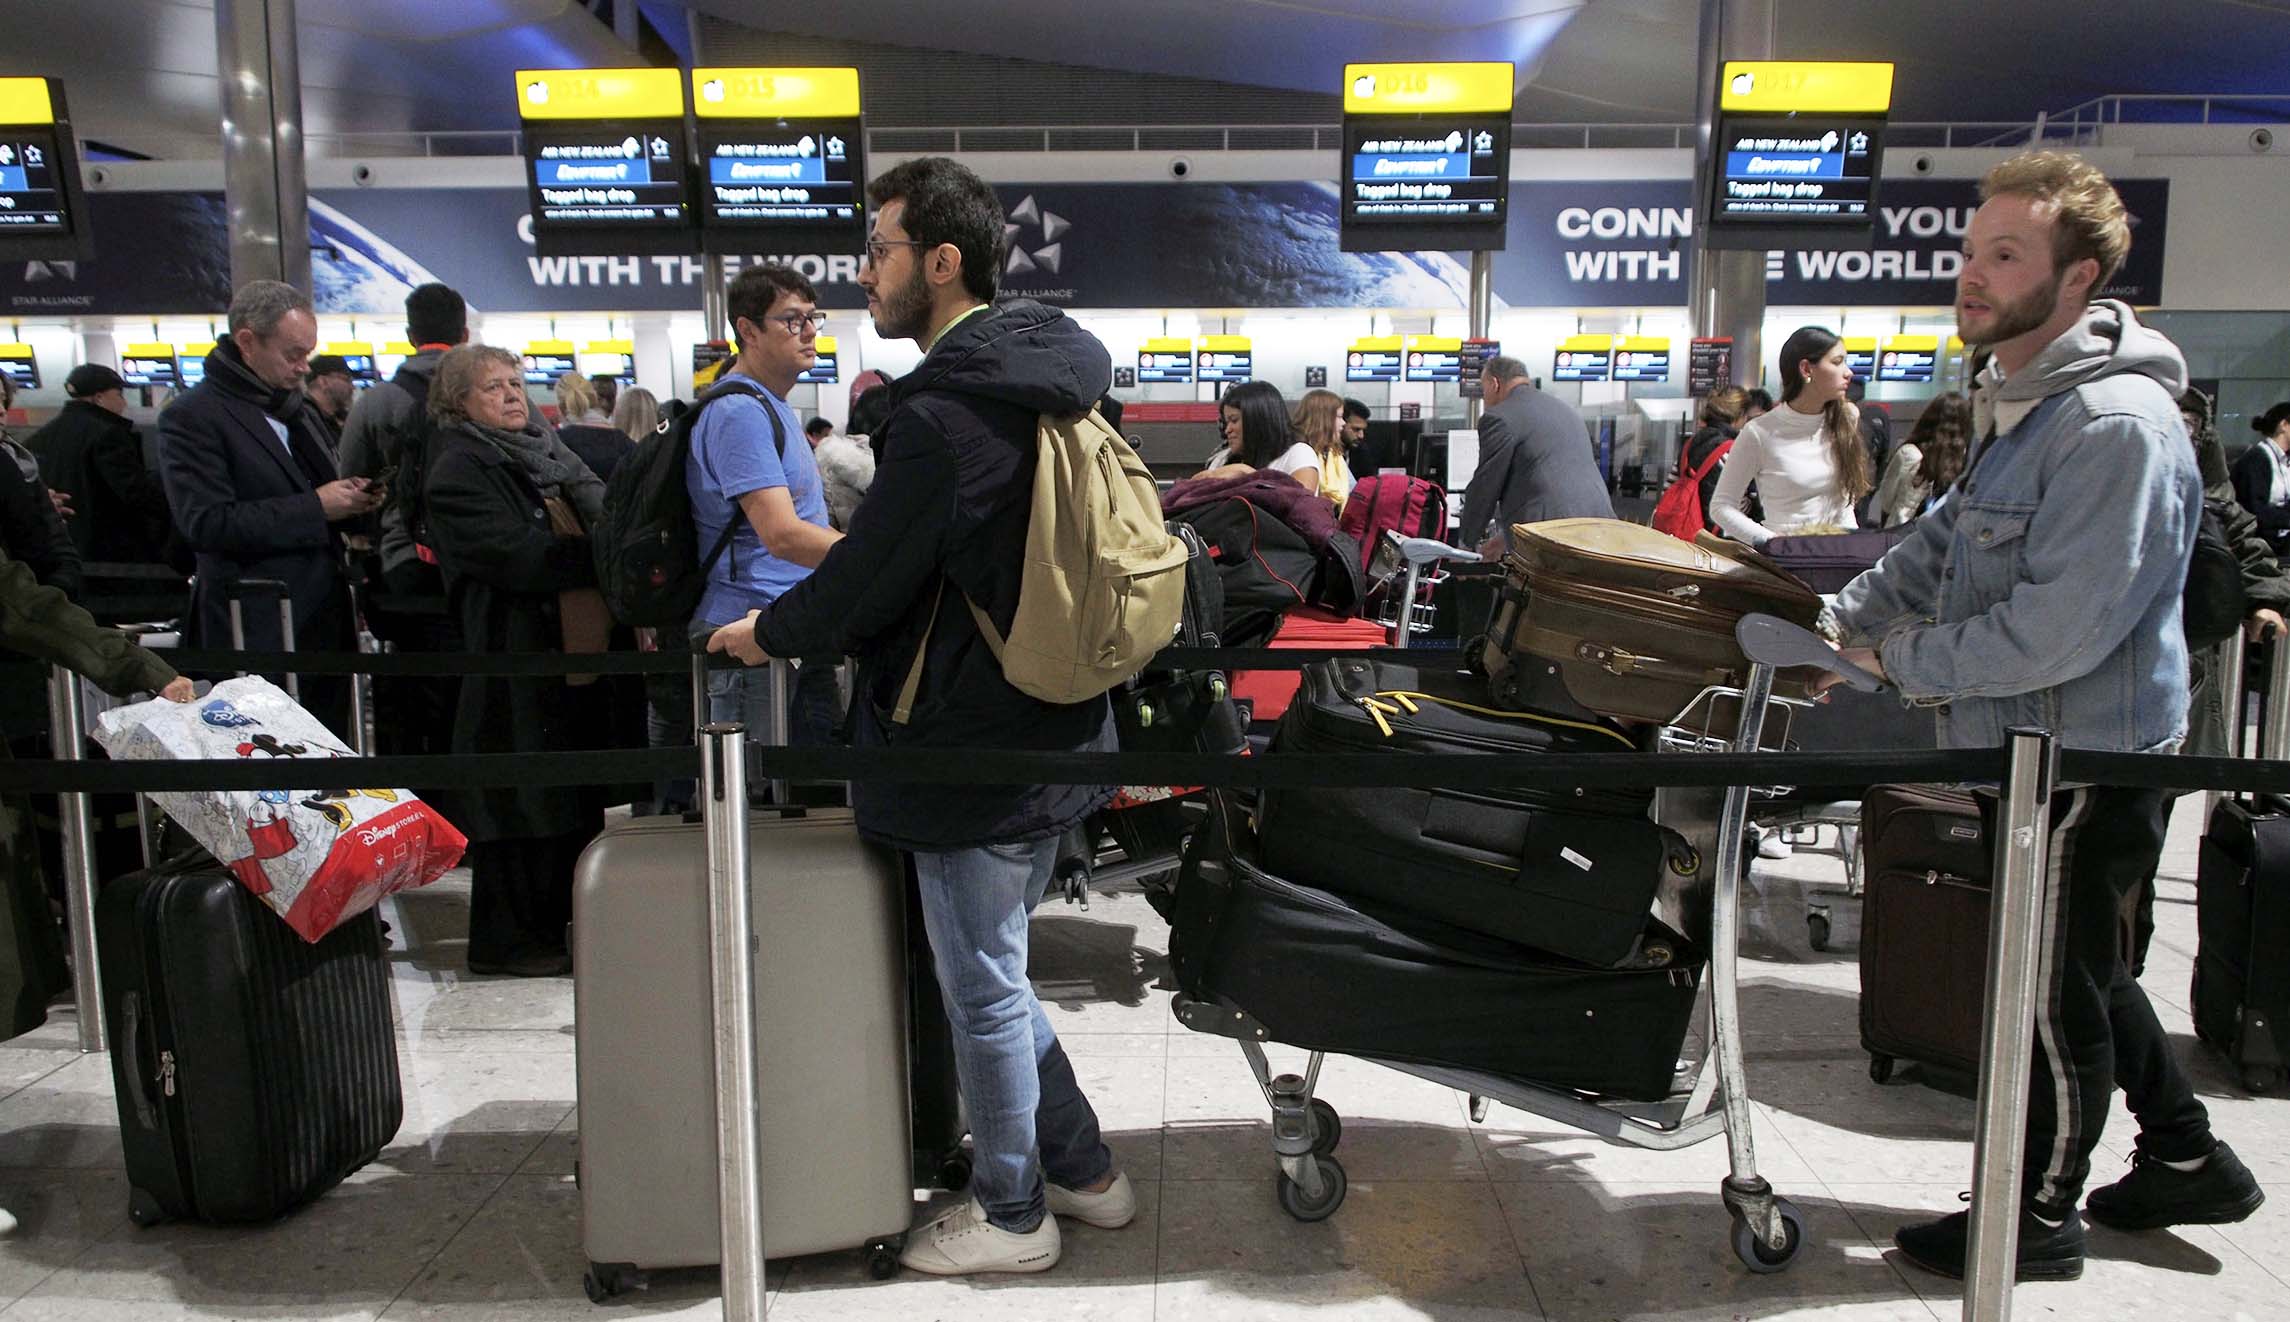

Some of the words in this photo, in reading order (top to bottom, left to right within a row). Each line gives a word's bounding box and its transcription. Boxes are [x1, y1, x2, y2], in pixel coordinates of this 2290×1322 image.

[733, 78, 775, 99] D15
[1384, 73, 1428, 93] D16
[1360, 141, 1379, 153] AIR
[1380, 141, 1401, 153] NEW
[1401, 141, 1445, 153] ZEALAND
[1736, 139, 1754, 151] AIR
[1755, 139, 1777, 151] NEW
[1776, 139, 1820, 151] ZEALAND
[541, 188, 583, 205] Tagged
[584, 188, 607, 205] bag
[607, 188, 637, 204] drop
[715, 186, 757, 203] Tagged
[758, 186, 781, 203] bag
[781, 186, 809, 203] drop
[1356, 182, 1399, 200] Tagged
[1400, 182, 1422, 200] bag
[1423, 182, 1451, 199] drop
[1728, 181, 1770, 198] Tagged
[1771, 182, 1794, 199] bag
[1795, 182, 1823, 199] drop
[528, 255, 640, 285] WITH
[1565, 251, 1680, 281] WITH
[1797, 251, 1964, 281] WORLD
[1021, 289, 1073, 297] ALLIANCE
